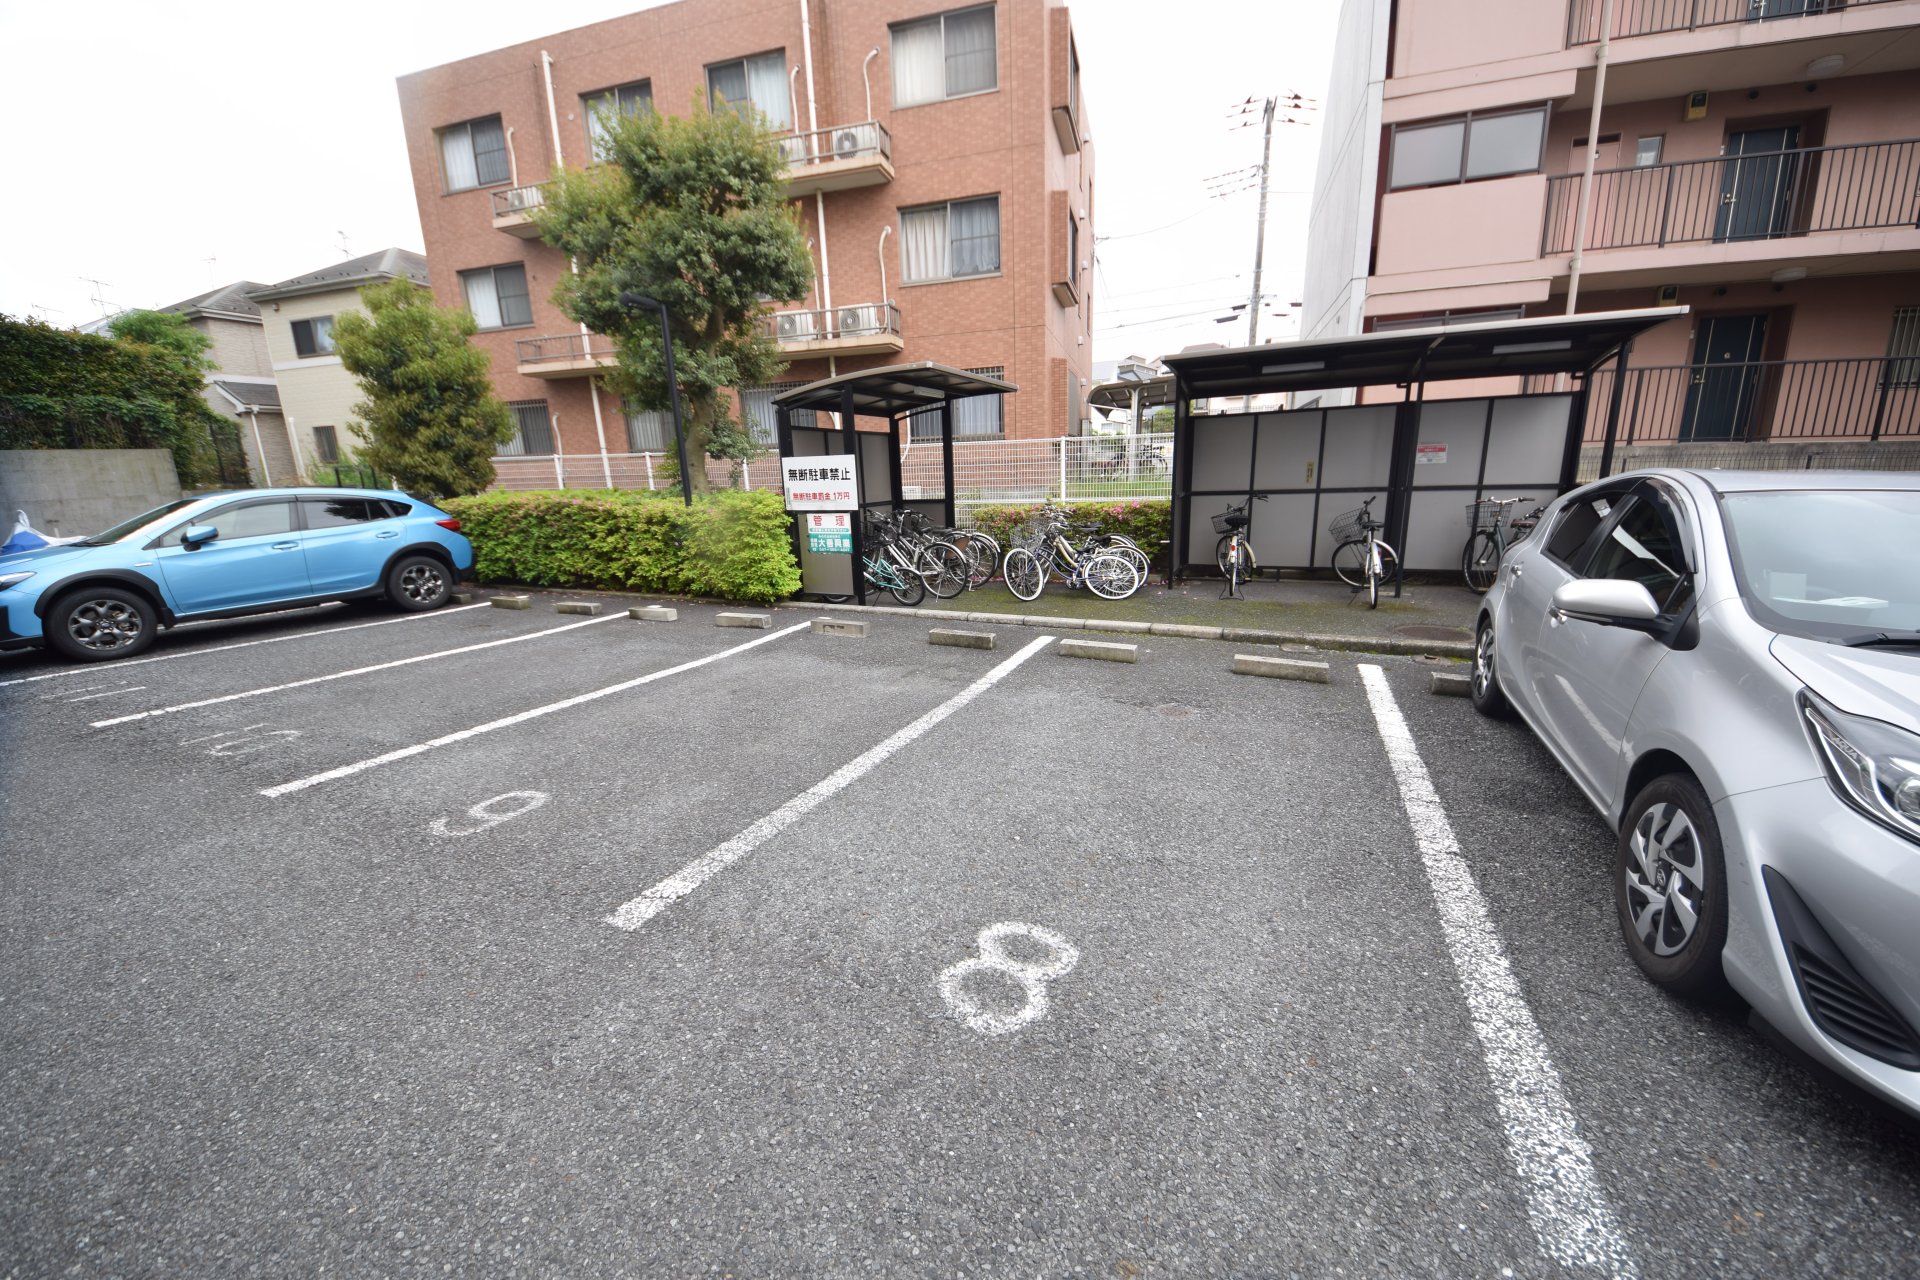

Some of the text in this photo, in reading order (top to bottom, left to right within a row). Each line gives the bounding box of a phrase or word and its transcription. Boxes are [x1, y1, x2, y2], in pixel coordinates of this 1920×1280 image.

[788, 467, 851, 481] 無断駐車禁止
[813, 515, 845, 526] 管理
[937, 921, 1081, 1036] 8
